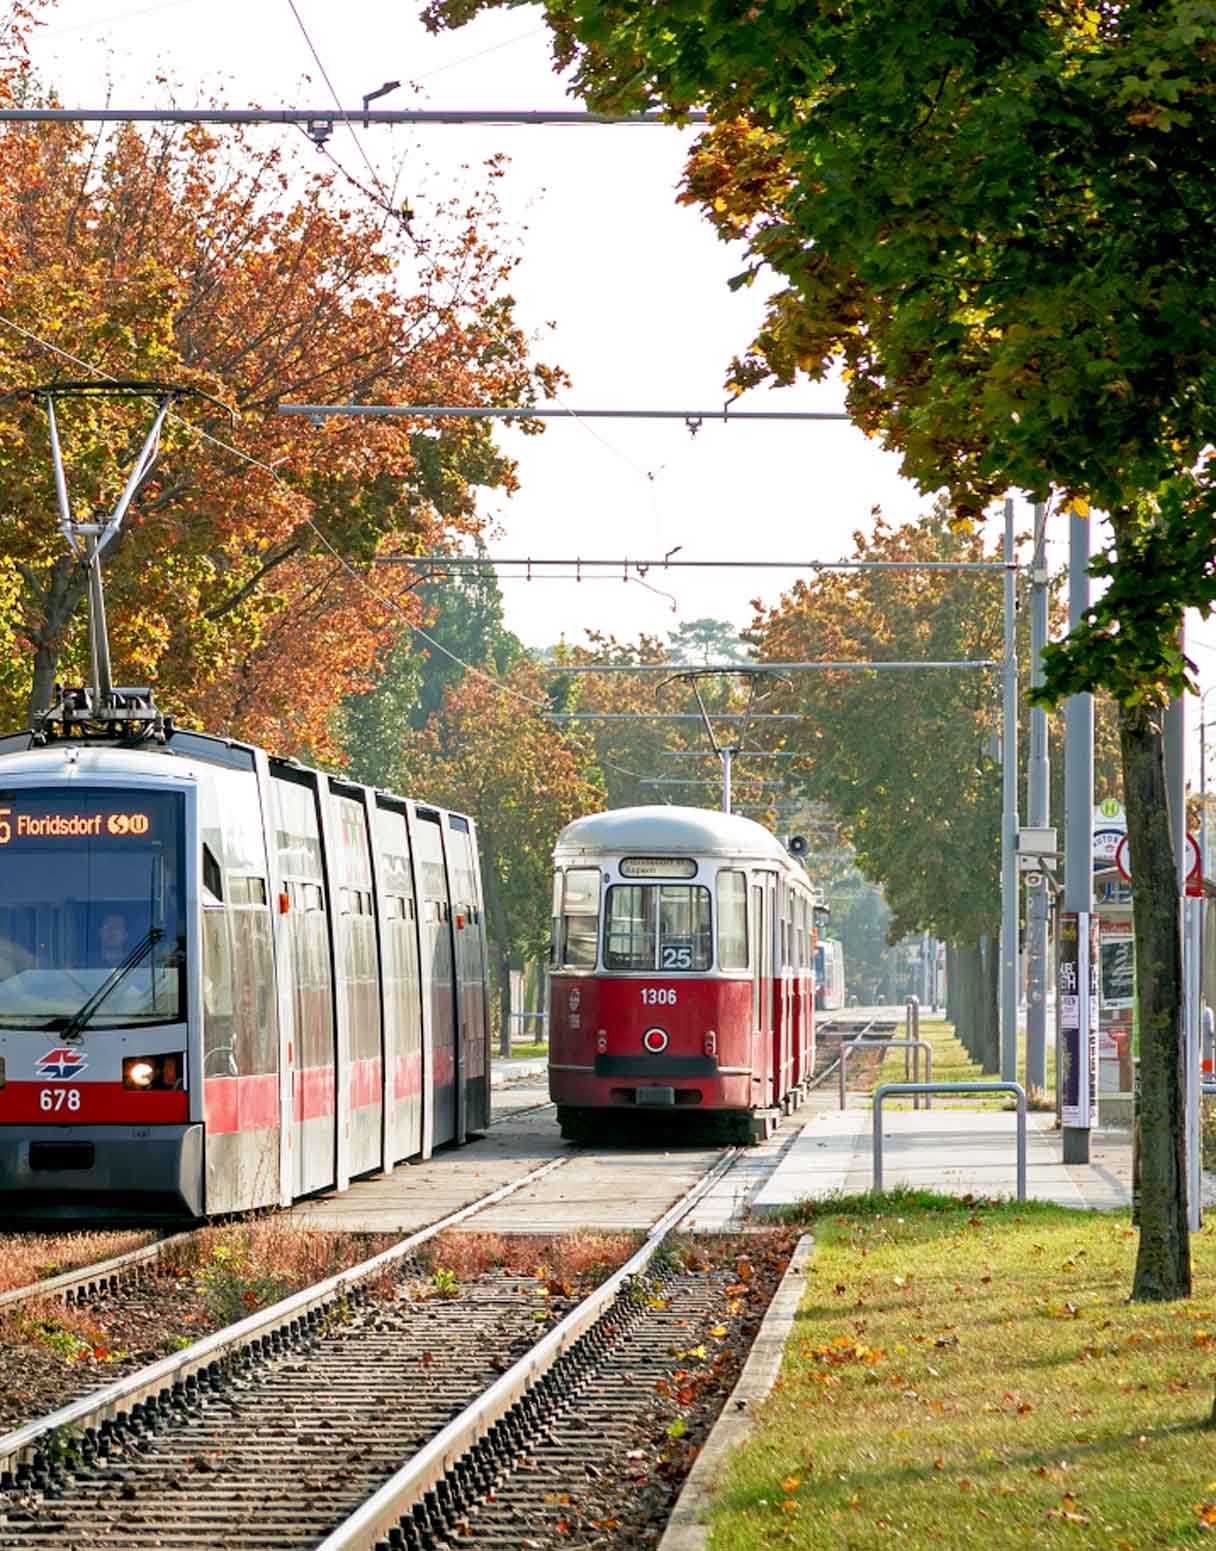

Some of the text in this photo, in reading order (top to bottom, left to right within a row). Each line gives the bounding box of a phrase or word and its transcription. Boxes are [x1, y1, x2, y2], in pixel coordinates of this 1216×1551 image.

[17, 814, 103, 835] Floridsdorf
[663, 948, 691, 969] 25
[640, 988, 677, 1005] 1306
[39, 1088, 81, 1111] 678
